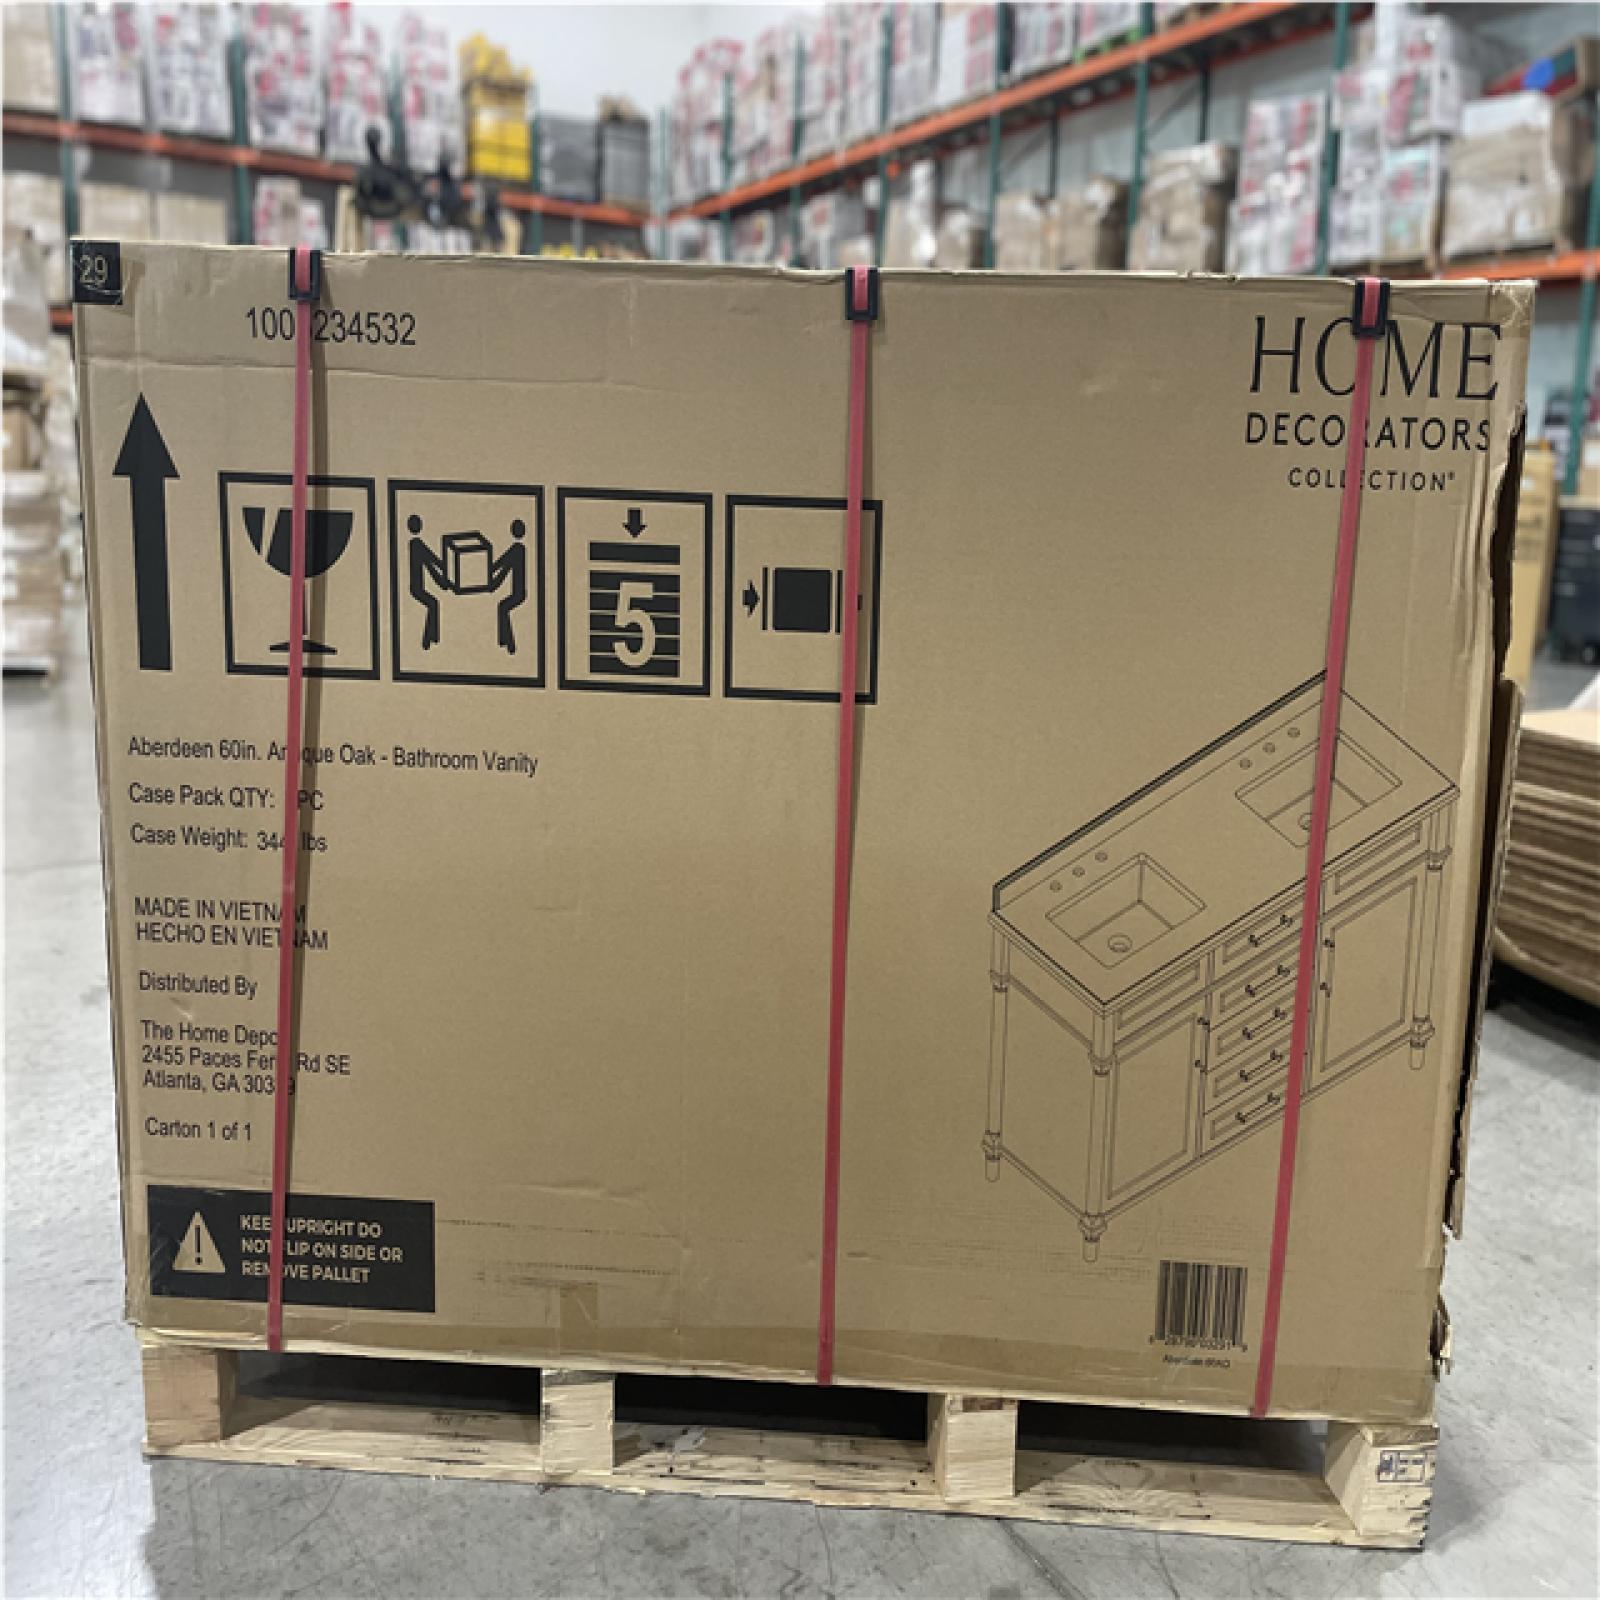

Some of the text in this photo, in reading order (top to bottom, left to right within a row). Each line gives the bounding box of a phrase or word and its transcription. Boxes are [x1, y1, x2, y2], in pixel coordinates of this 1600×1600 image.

[246, 307, 416, 346] 100234532
[1250, 315, 1501, 401] HOME
[1245, 412, 1489, 451] DECOATORS
[614, 581, 656, 667] 5
[128, 737, 214, 759] Aberdeen
[219, 739, 262, 761] 60in.
[339, 743, 376, 765] Oak
[392, 745, 478, 771] Bathroom
[482, 749, 538, 778] Vanity
[128, 782, 176, 805] Case
[180, 784, 225, 807] Pack
[229, 786, 275, 808] QTY:
[130, 822, 176, 845] Case
[181, 824, 248, 853] Weight:
[134, 897, 306, 924] MADE IN VIETNM
[136, 922, 206, 943] HECHO
[211, 924, 237, 946] EN
[139, 969, 258, 1000] Distributed By
[140, 1019, 280, 1048] The Home Depo
[141, 1045, 351, 1075] 2455 Paces Fer Rd SE
[143, 1069, 207, 1093] Atlanta,
[211, 1072, 241, 1093] GA
[144, 1116, 251, 1141] Carton 1 of 1
[239, 1214, 383, 1238] KEE UPRIGHT DO
[284, 1240, 311, 1256] LIP
[312, 1242, 336, 1258] ON
[340, 1244, 376, 1261] SIDE
[379, 1247, 403, 1263] OR
[312, 1265, 371, 1284] PALLET
